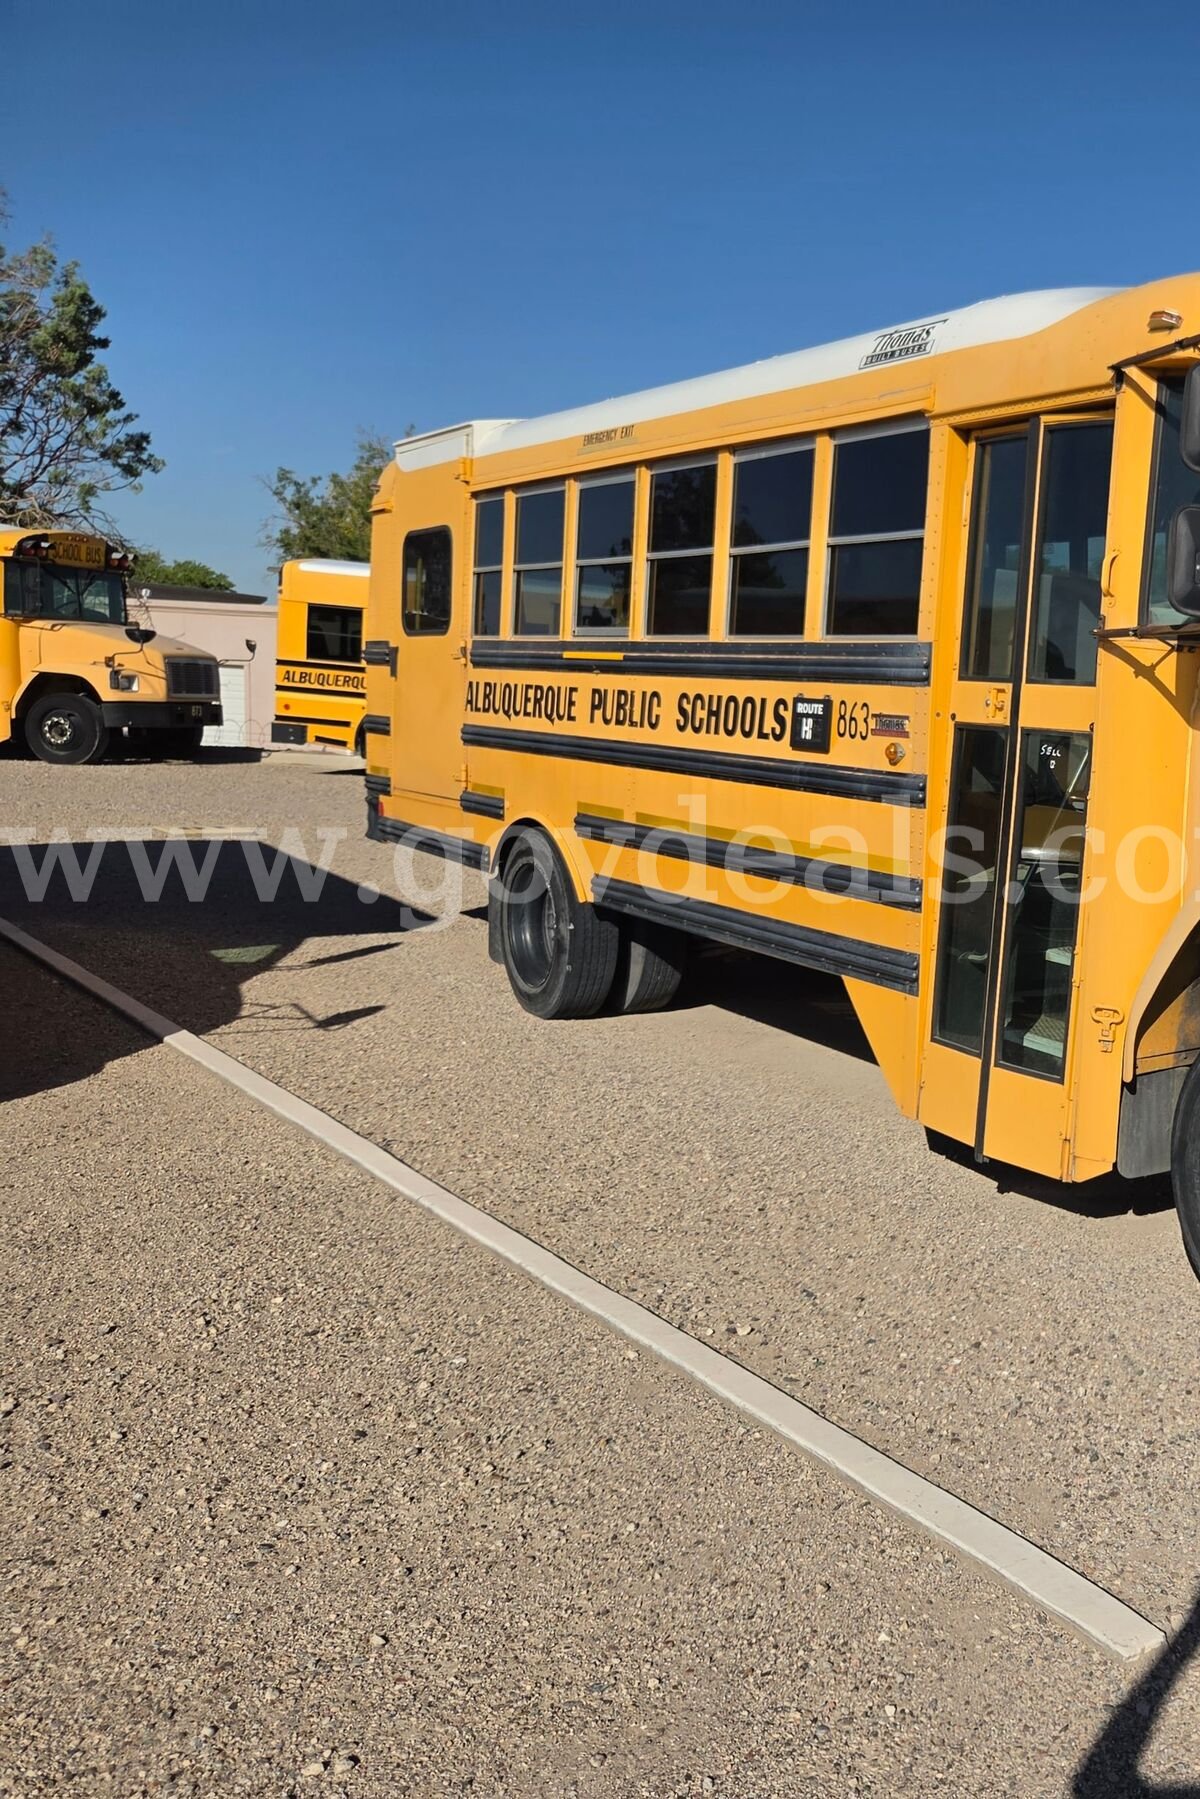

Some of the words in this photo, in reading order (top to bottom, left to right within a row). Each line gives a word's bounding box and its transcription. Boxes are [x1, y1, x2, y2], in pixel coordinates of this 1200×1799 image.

[872, 319, 949, 354] Thomas
[865, 351, 892, 365] BUILT
[894, 342, 927, 359] BUSES
[465, 681, 579, 727] ALBUQUERQUE
[589, 687, 662, 731] PUBLIC
[676, 692, 789, 742] SCHOOLS
[797, 702, 824, 715] ROUTE
[837, 699, 870, 741] 863
[1040, 744, 1061, 757] SELL
